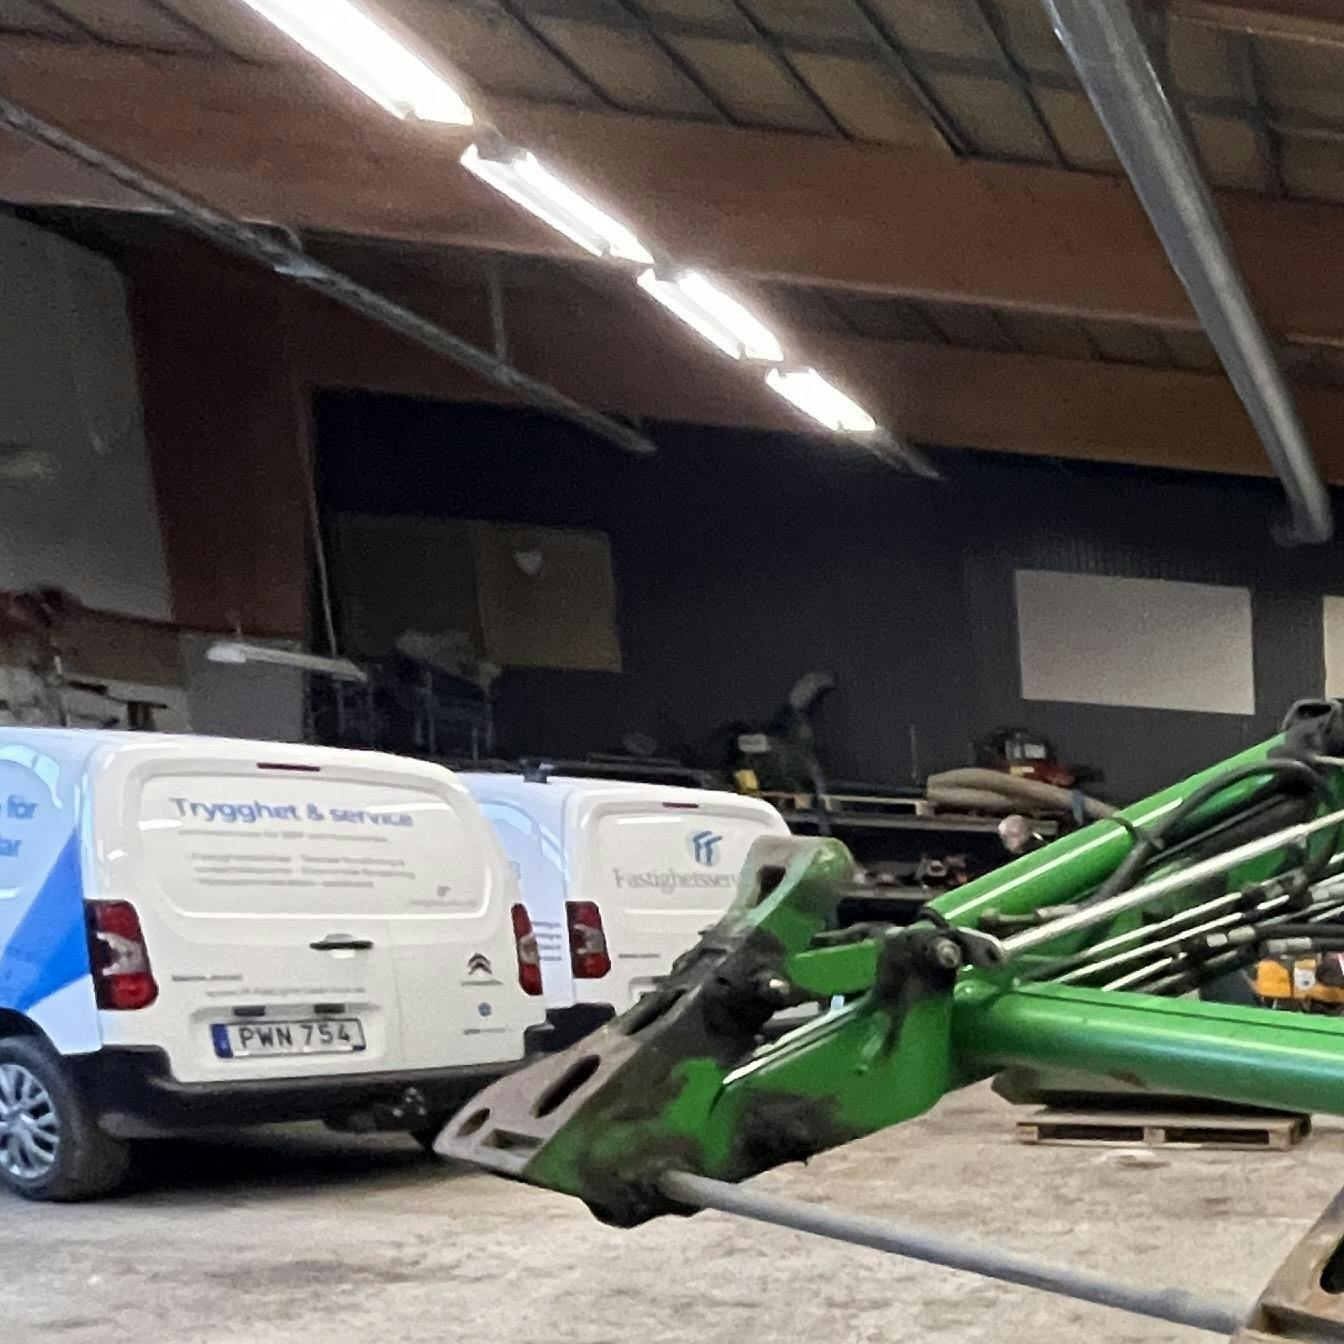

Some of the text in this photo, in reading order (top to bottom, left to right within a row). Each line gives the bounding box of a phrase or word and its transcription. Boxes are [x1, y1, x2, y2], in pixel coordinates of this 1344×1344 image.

[169, 797, 414, 828] Trygghet & service
[238, 1023, 350, 1048] PWN 754
